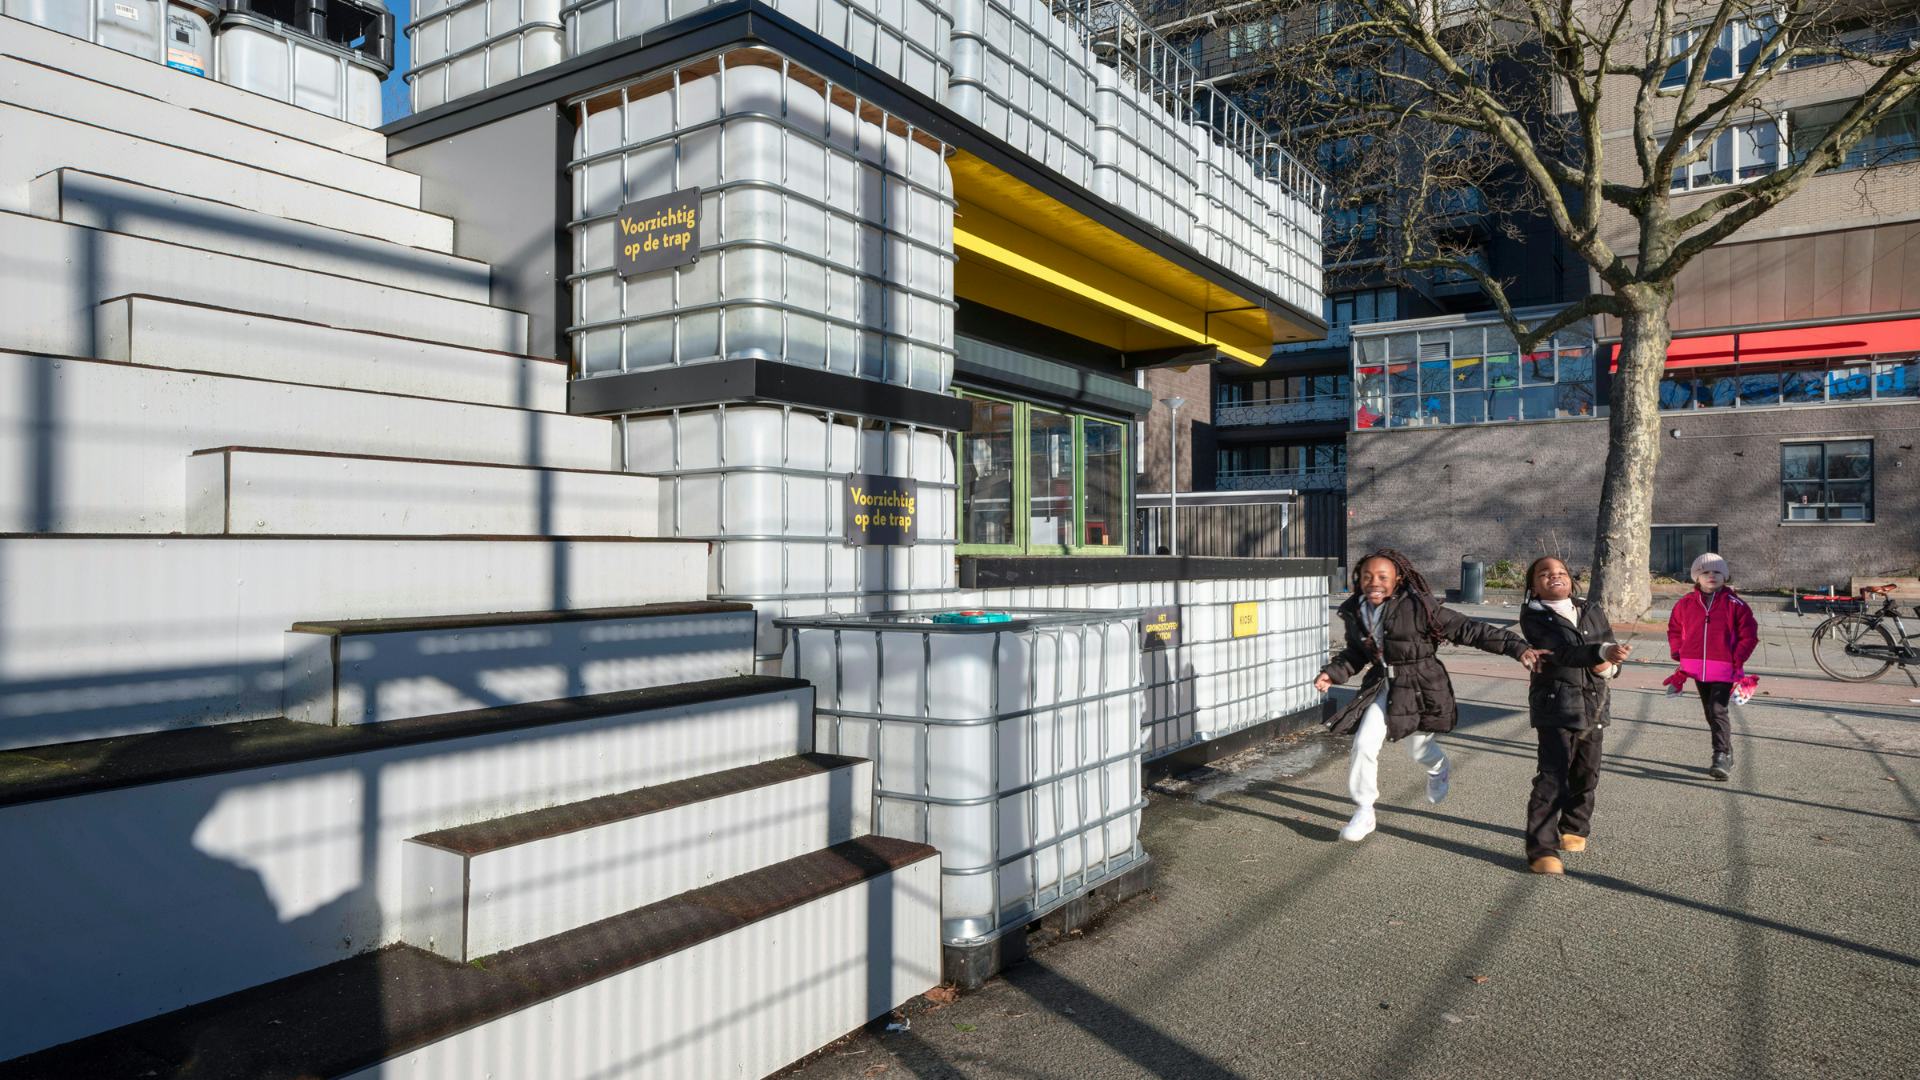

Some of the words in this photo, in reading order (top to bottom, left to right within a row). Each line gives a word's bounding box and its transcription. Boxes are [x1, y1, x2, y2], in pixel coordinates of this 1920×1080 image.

[621, 204, 695, 235] Voorzichtig
[624, 242, 640, 262] op
[643, 233, 660, 252] de
[663, 231, 691, 251] trap
[850, 486, 915, 515] Voorzichtig
[854, 513, 870, 532] op
[872, 508, 887, 526] de
[889, 512, 912, 533] trap
